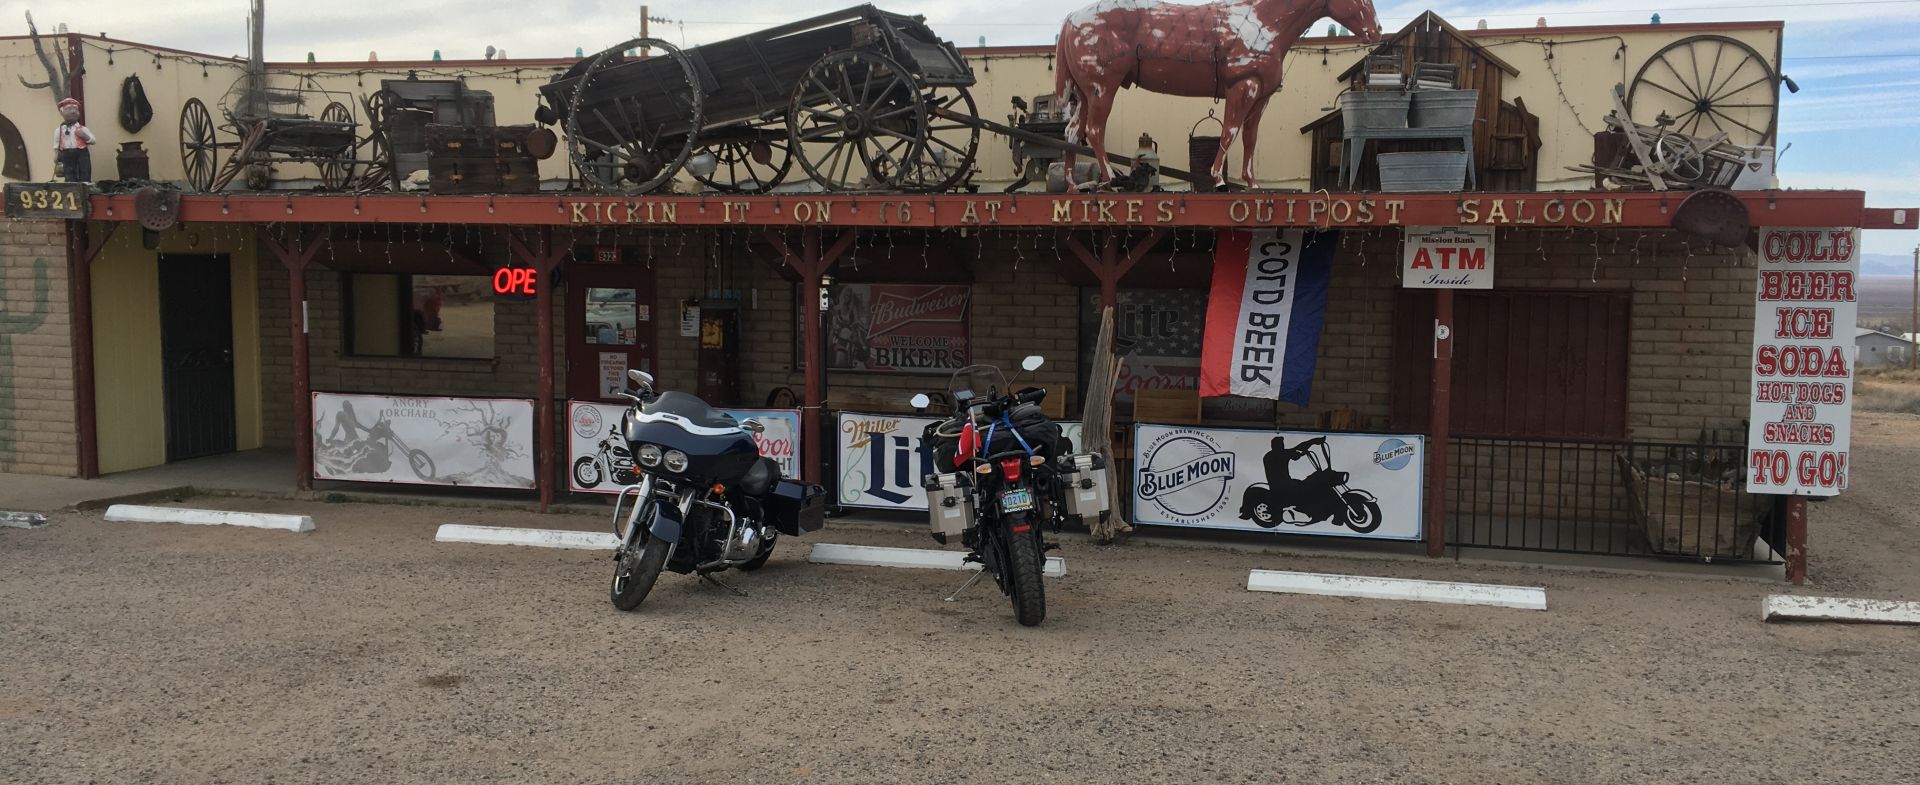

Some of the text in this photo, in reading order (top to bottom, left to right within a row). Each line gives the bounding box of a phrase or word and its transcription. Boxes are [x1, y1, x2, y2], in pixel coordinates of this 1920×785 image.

[21, 191, 78, 210] 9321
[571, 202, 677, 223] KICKIN
[723, 201, 750, 223] IT
[794, 202, 832, 223] ON
[960, 200, 1001, 223] AT
[1052, 199, 1174, 223] MIKES
[1460, 199, 1625, 223] SALOON
[1763, 231, 1854, 262] COLD
[1411, 248, 1485, 270] ATM
[494, 268, 536, 294] OPE
[1422, 274, 1472, 286] Inside
[1759, 270, 1856, 302] BEER
[871, 292, 967, 325] Budweiser
[1775, 307, 1834, 339] ICE
[889, 336, 950, 348] WELCOME
[875, 348, 966, 369] BIKERS
[1756, 345, 1849, 378] SODA
[393, 400, 429, 408] ANGRY
[1757, 381, 1846, 405] HOT DOGS
[386, 408, 436, 419] ORCHARD
[1784, 404, 1816, 422] AND
[842, 420, 898, 444] Miller
[1156, 431, 1173, 444] MOON
[1175, 429, 1205, 437] BREWING
[1764, 422, 1835, 445] SNACKS
[1374, 445, 1414, 463] BLUE MOON
[864, 432, 934, 504] Lit
[1141, 457, 1231, 496] BLUE MOON
[1751, 449, 1847, 488] TO GO!
[1161, 511, 1215, 524] ESTABLISHED
